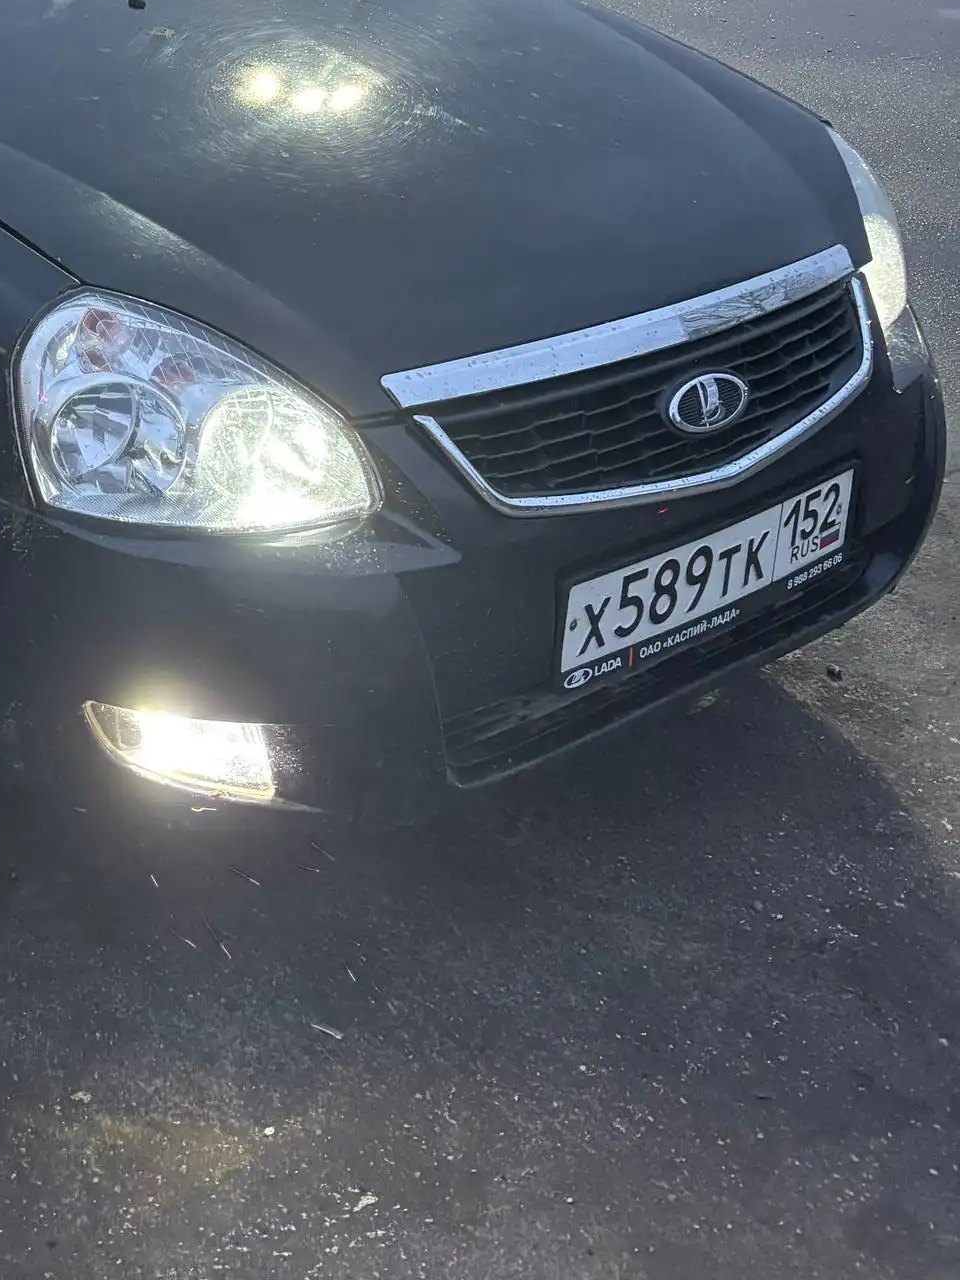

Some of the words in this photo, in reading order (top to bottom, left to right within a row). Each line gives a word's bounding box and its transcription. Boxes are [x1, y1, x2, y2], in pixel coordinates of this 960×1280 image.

[790, 536, 819, 564] RUS
[576, 529, 770, 657] Х589ТК
[784, 483, 840, 547] 152
[640, 641, 661, 658] ОАО
[594, 656, 622, 676] LADA
